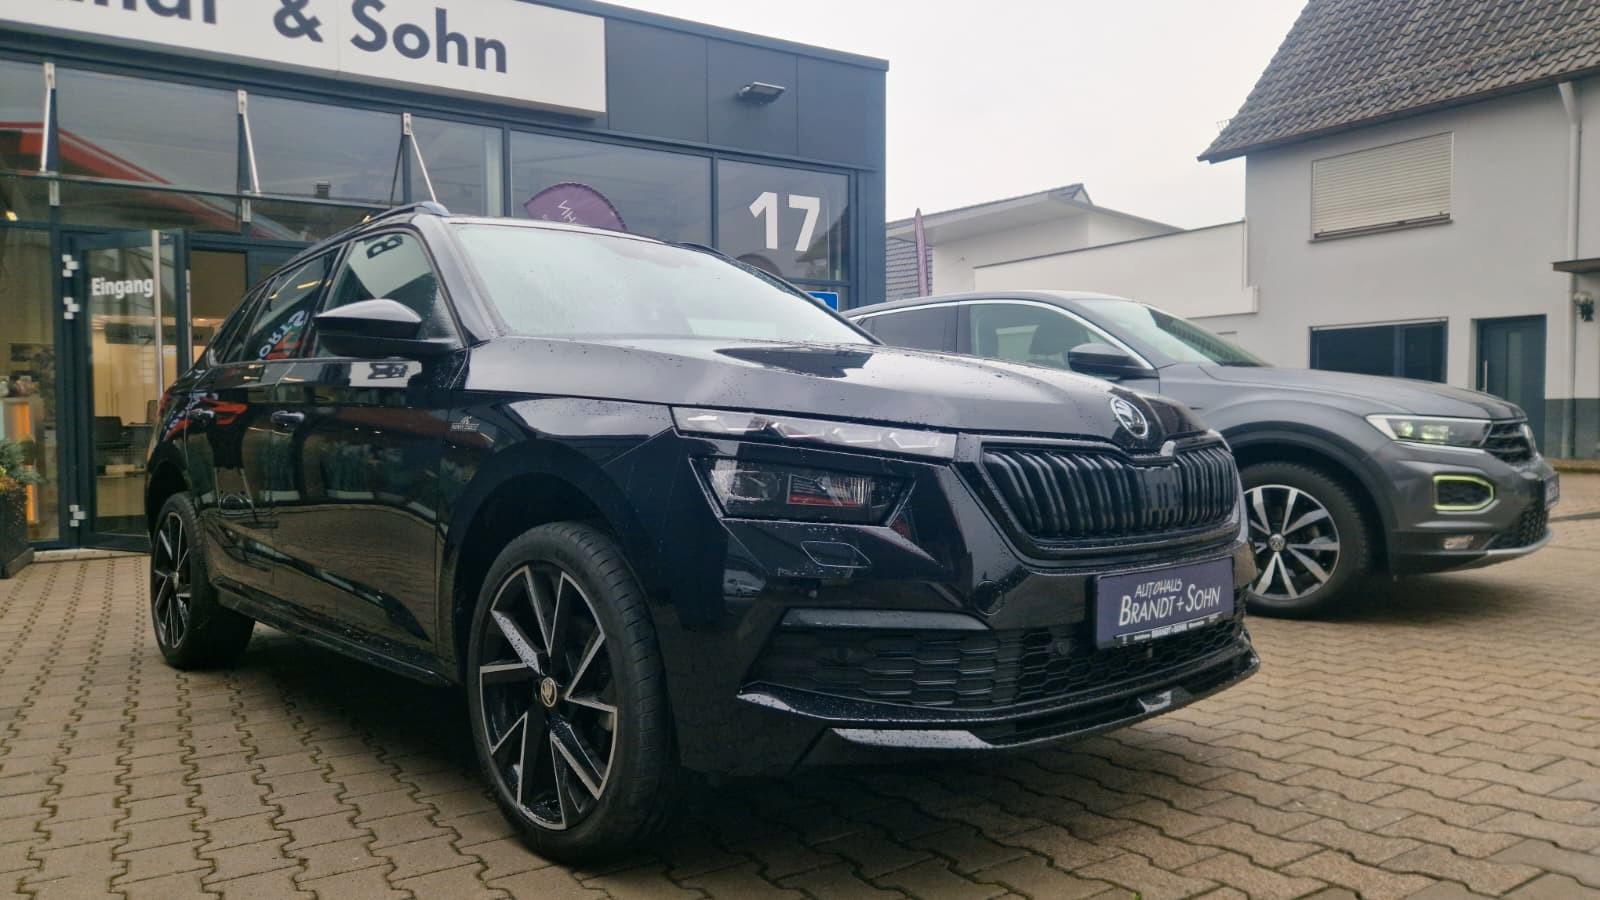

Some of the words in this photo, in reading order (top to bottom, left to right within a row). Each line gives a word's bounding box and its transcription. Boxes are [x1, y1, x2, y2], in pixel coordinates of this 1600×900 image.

[273, 0, 323, 43] &
[350, 0, 507, 73] Sohn
[749, 191, 820, 252] 17
[91, 277, 154, 299] Eingang
[1134, 578, 1183, 599] AUTOHAUS
